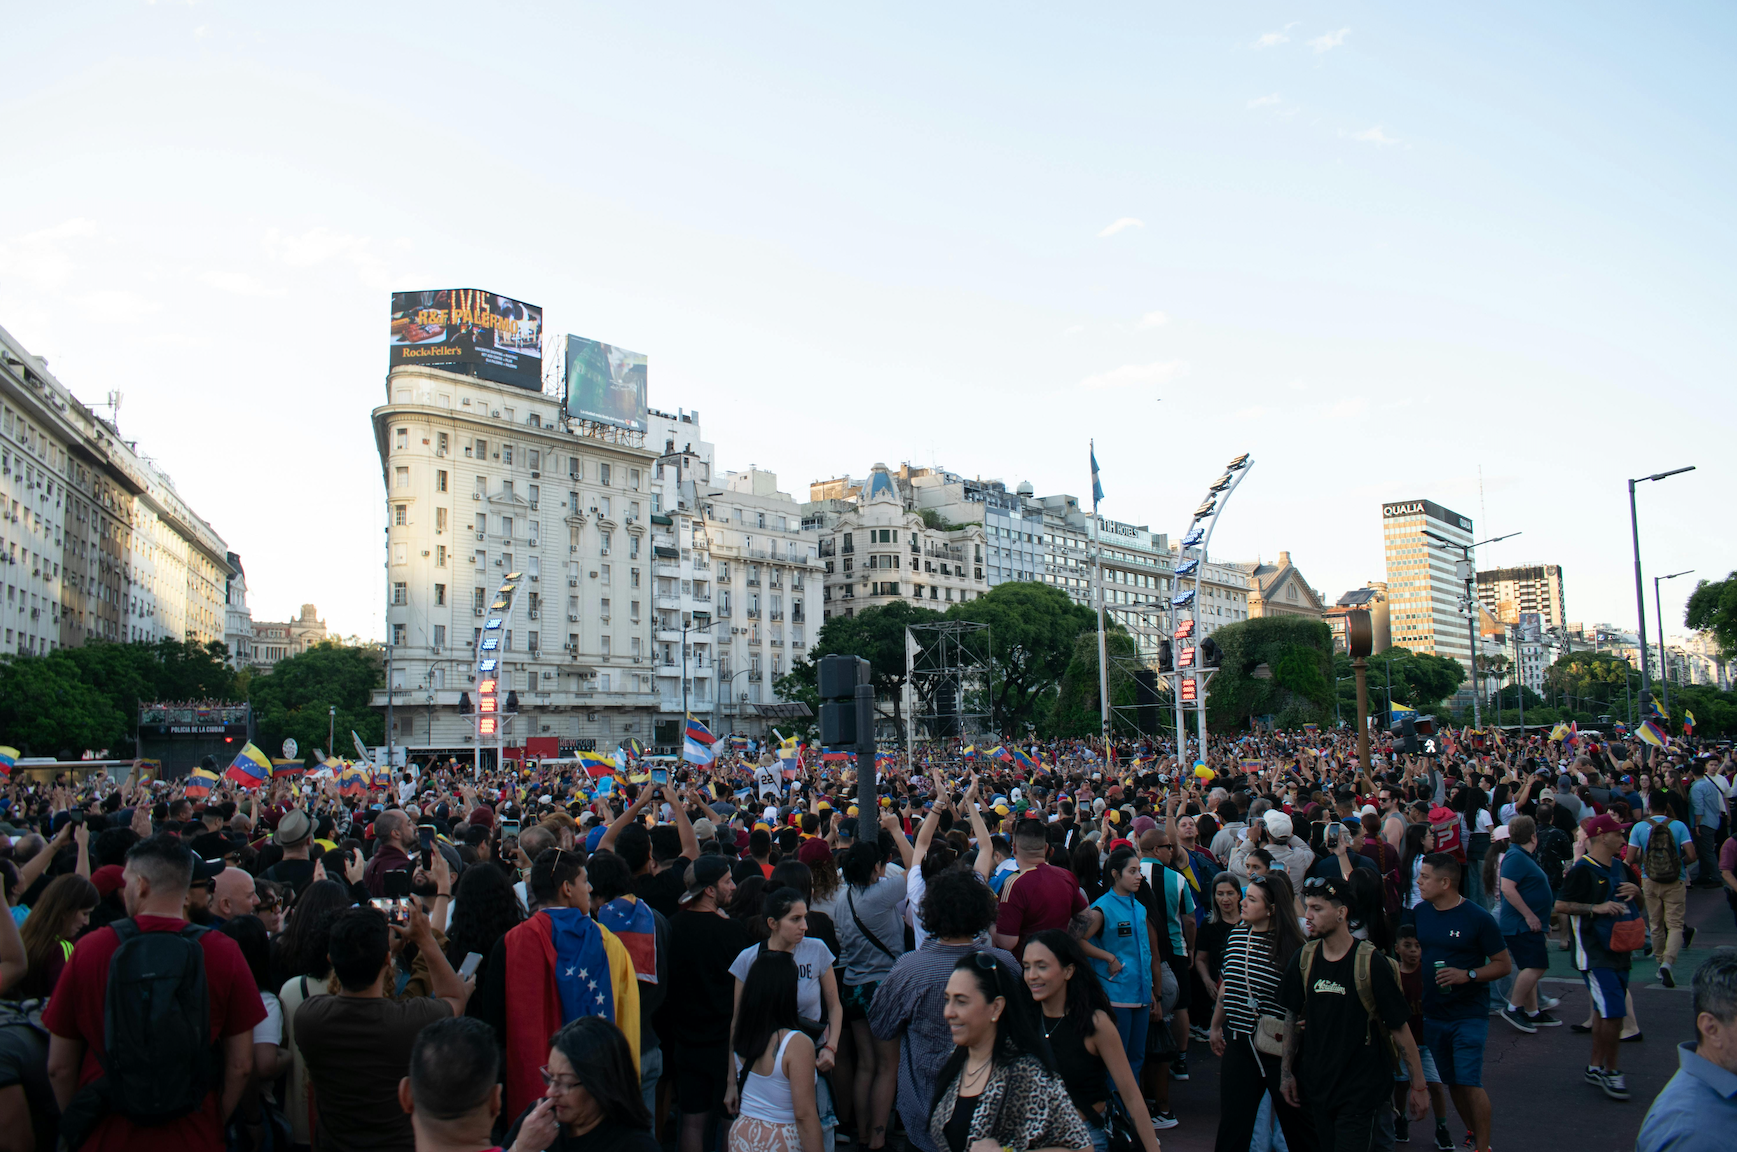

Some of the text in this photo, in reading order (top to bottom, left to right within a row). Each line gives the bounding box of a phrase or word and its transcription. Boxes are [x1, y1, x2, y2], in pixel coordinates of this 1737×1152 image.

[453, 309, 519, 335] PALERMO
[1383, 502, 1425, 517] QUALIA
[1117, 524, 1139, 539] HOTELS
[170, 721, 226, 733] POLICIA DE LA CIUDAD
[761, 773, 775, 785] 22
